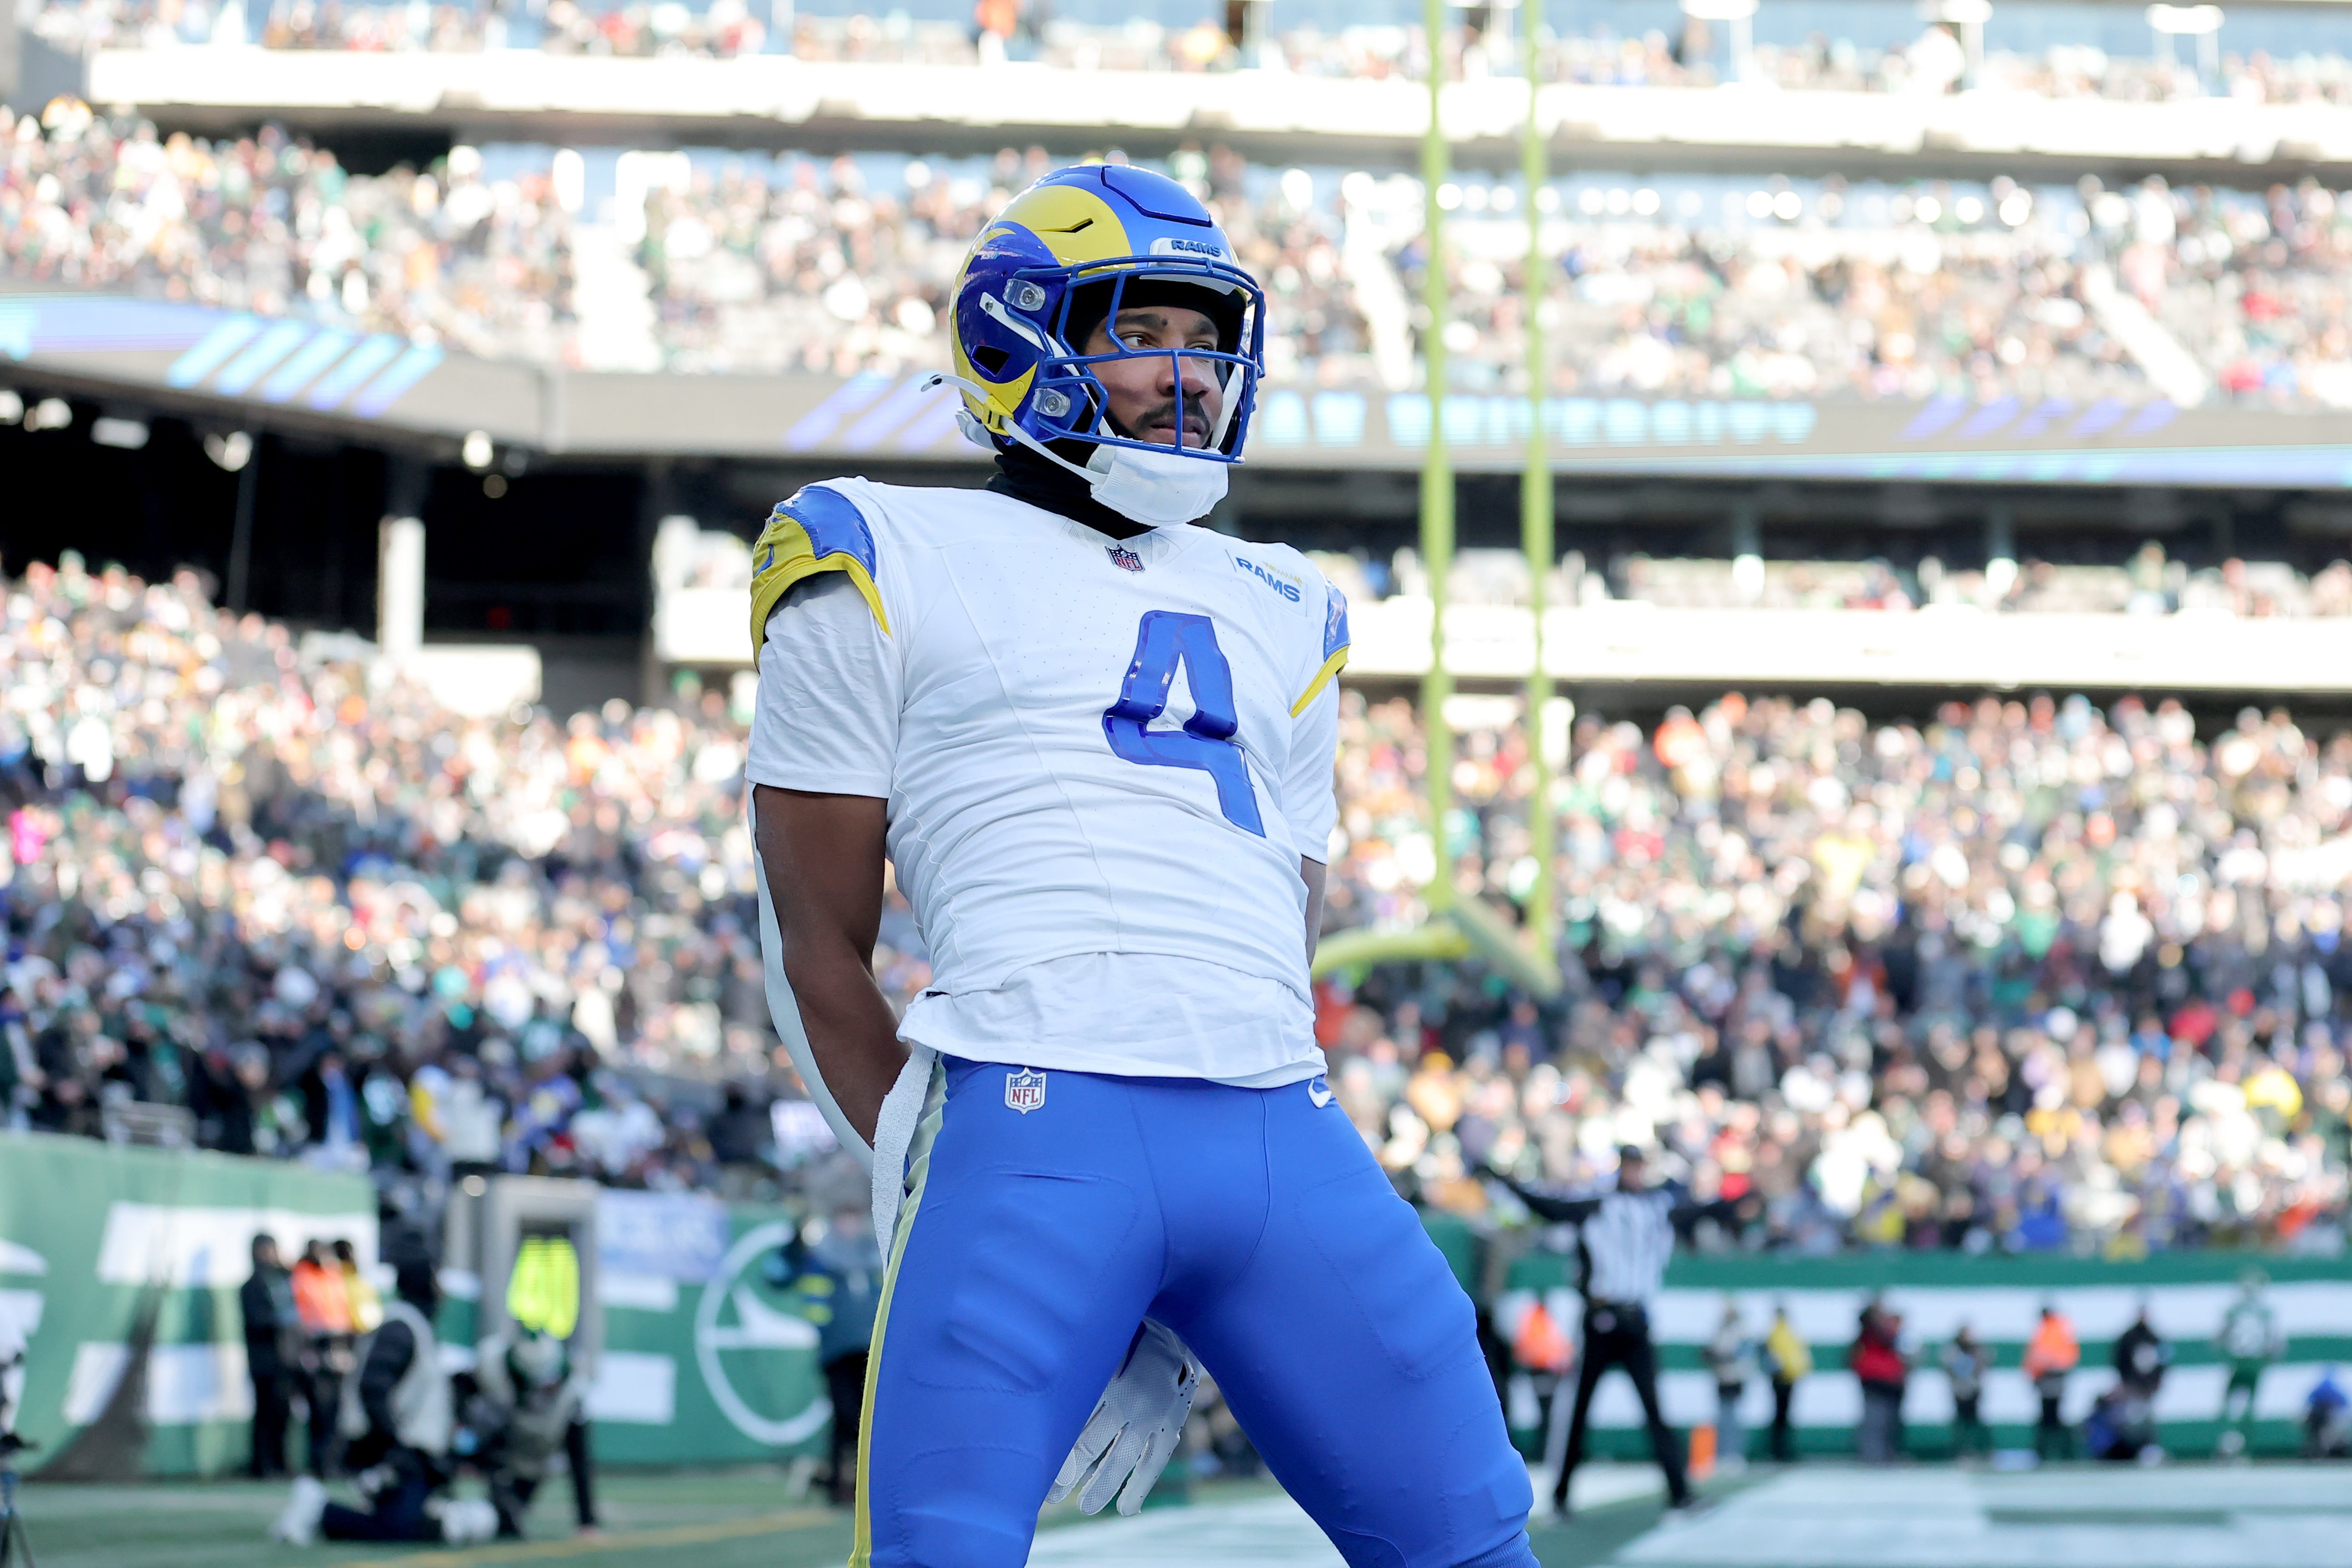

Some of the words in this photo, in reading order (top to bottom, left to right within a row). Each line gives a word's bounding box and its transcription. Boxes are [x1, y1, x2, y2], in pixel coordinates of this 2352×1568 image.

[1171, 240, 1221, 257] RAMS
[1116, 556, 1141, 569] NFL
[1235, 557, 1300, 602] RAMS
[1101, 610, 1266, 838] 4
[1012, 1089, 1039, 1105] NFL
